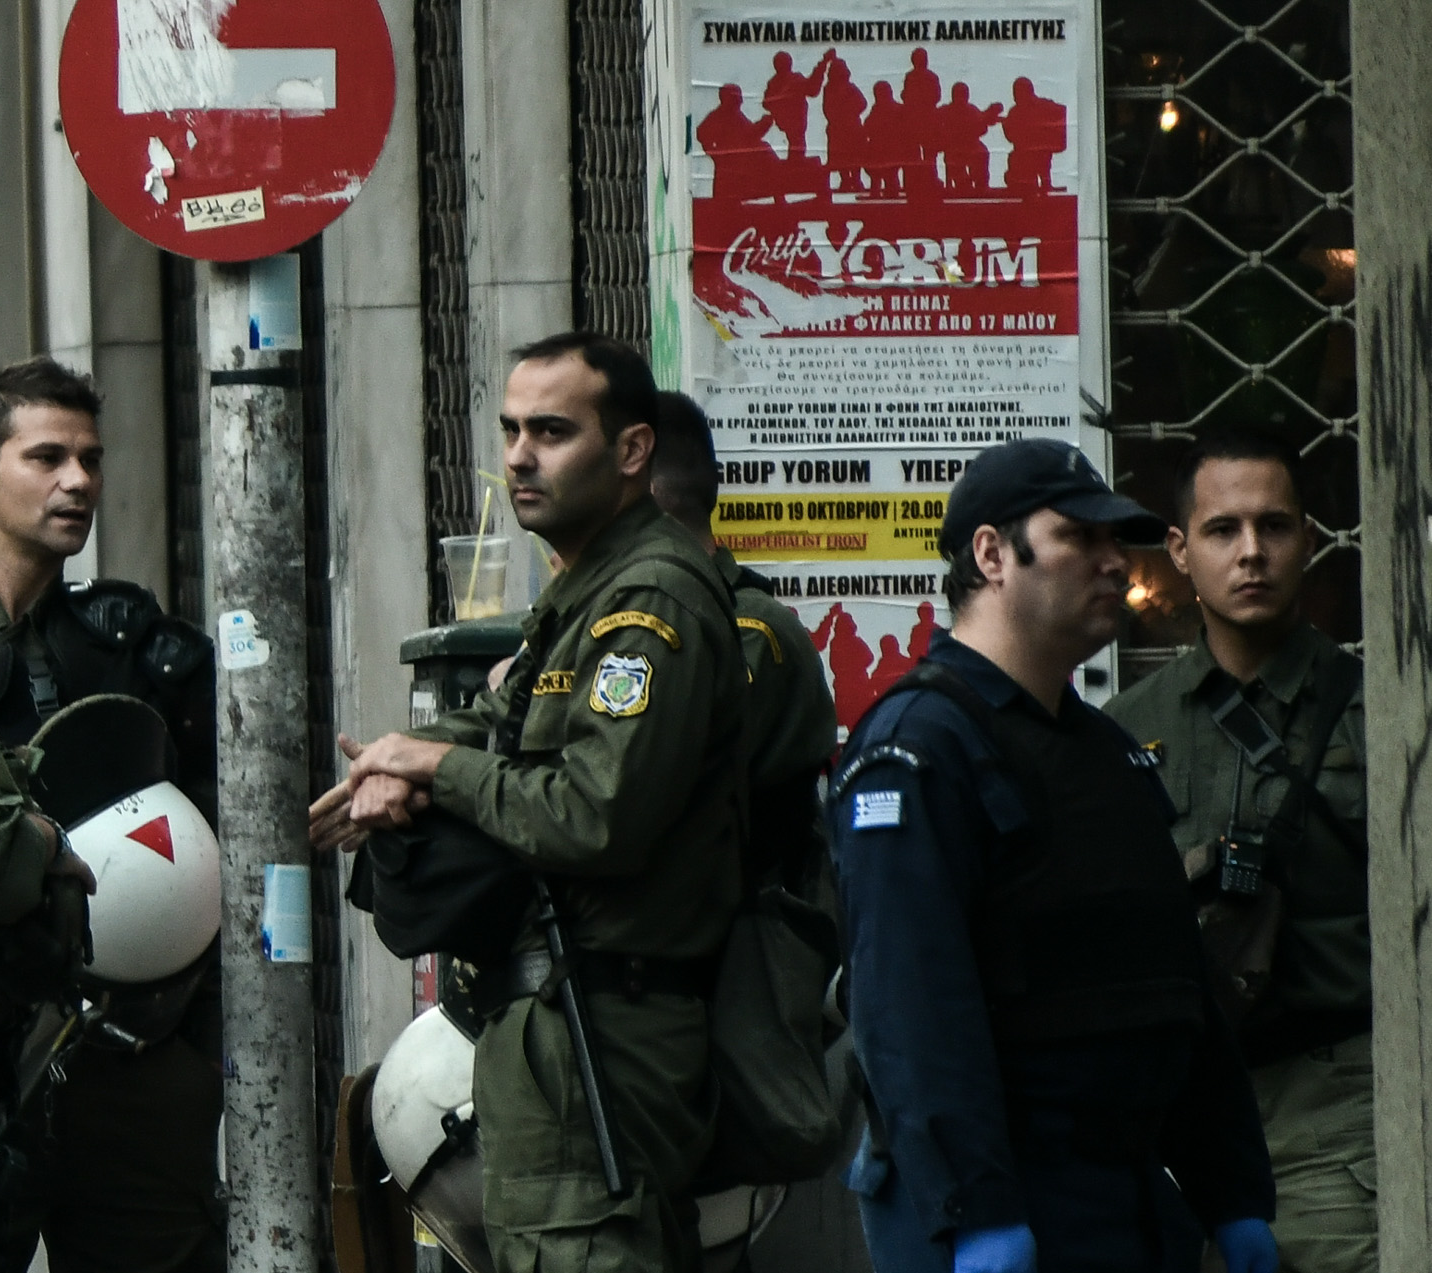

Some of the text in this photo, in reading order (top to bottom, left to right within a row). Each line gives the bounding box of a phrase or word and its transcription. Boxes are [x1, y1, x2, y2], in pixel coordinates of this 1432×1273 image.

[703, 19, 1066, 43] ΣΥΝΑΥΛΙΑ ΔΙΕΘΝΙΣΤΙΚΗΣ ΑΛΛΗΛΕΓΓΥΗΣ
[891, 295, 950, 312] ΠΕΙΝΑΣ
[853, 314, 932, 331] ΦΥΛΑΚΕΣ
[938, 315, 972, 330] ΑΠΟ
[979, 314, 996, 330] 17
[1002, 311, 1056, 330] ΜΑΪΟΥ
[782, 459, 871, 485] YORUM
[718, 499, 944, 522] ΣΑΒΒΑΤΟ 19 ΟΚΤΩΒΡΙΟΥ 20.00
[806, 574, 937, 598] ΔΙΕΘΝΙΣΤΙΚΗΣ
